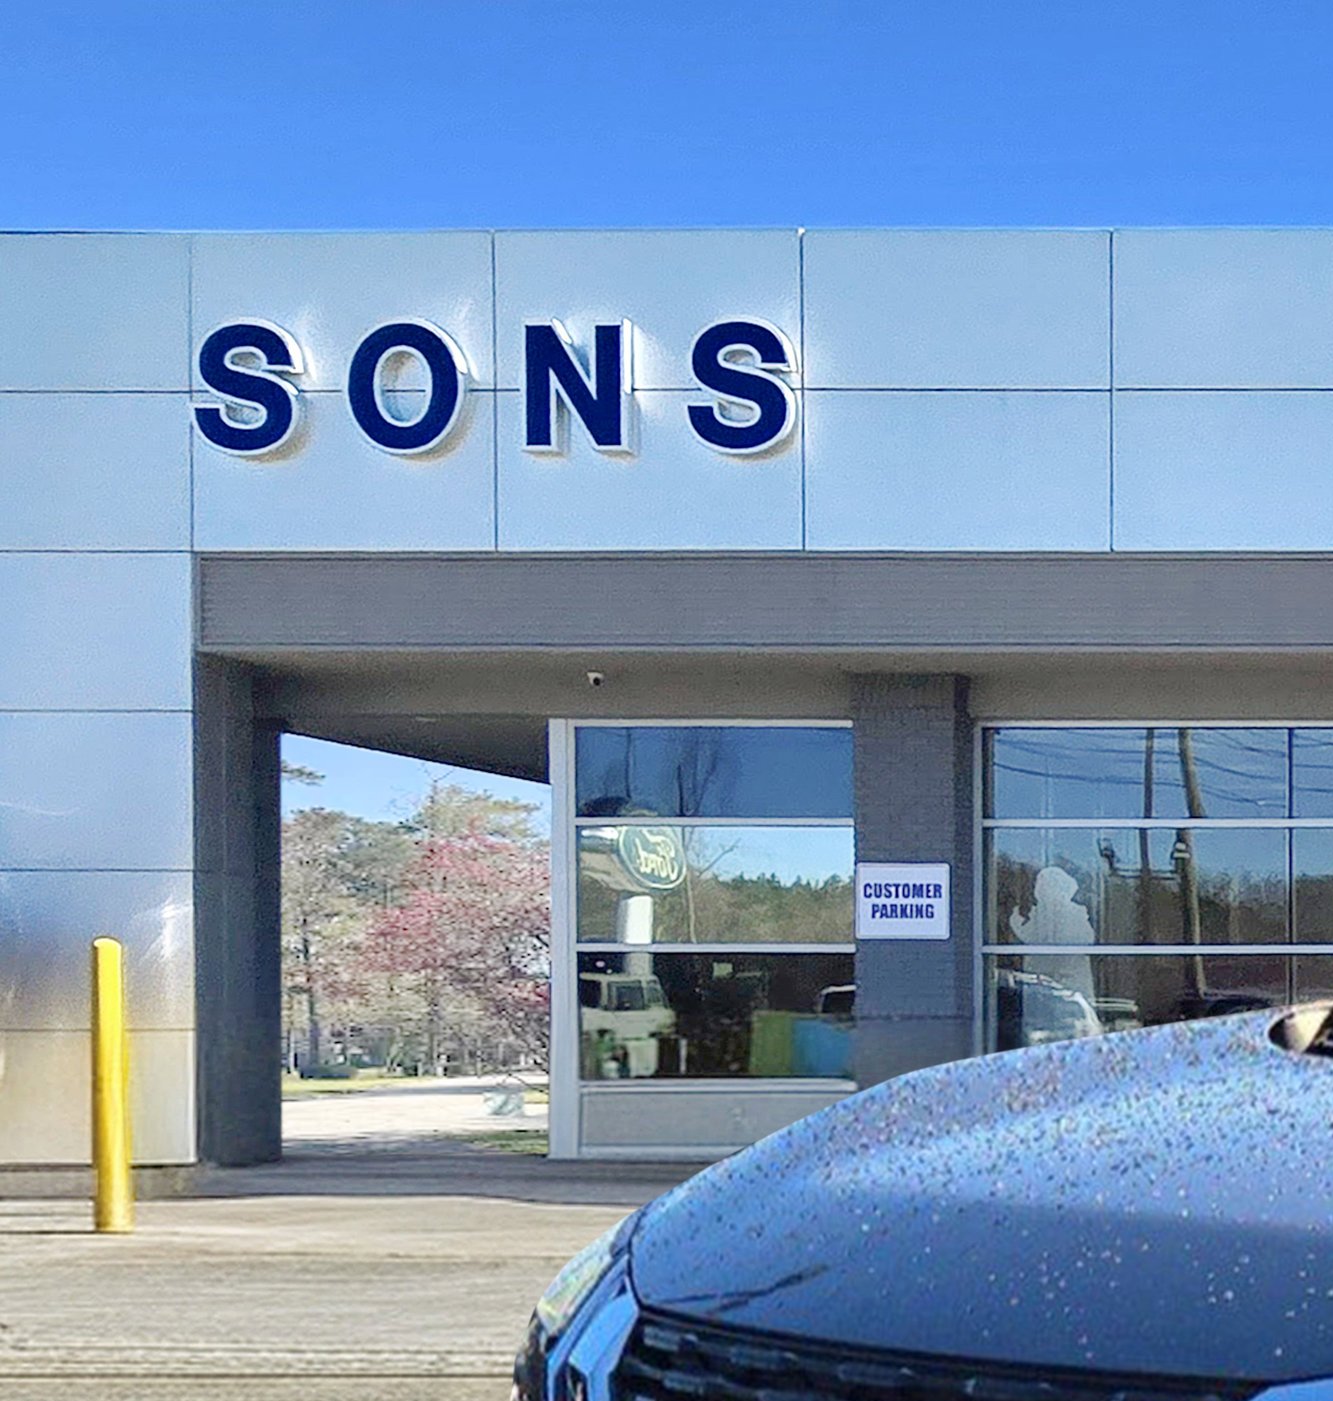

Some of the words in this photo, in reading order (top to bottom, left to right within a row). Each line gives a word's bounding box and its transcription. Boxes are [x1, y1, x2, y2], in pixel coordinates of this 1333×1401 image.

[192, 320, 796, 452] SONS
[863, 882, 942, 899] CUSTOMER
[871, 903, 935, 919] PARKING
